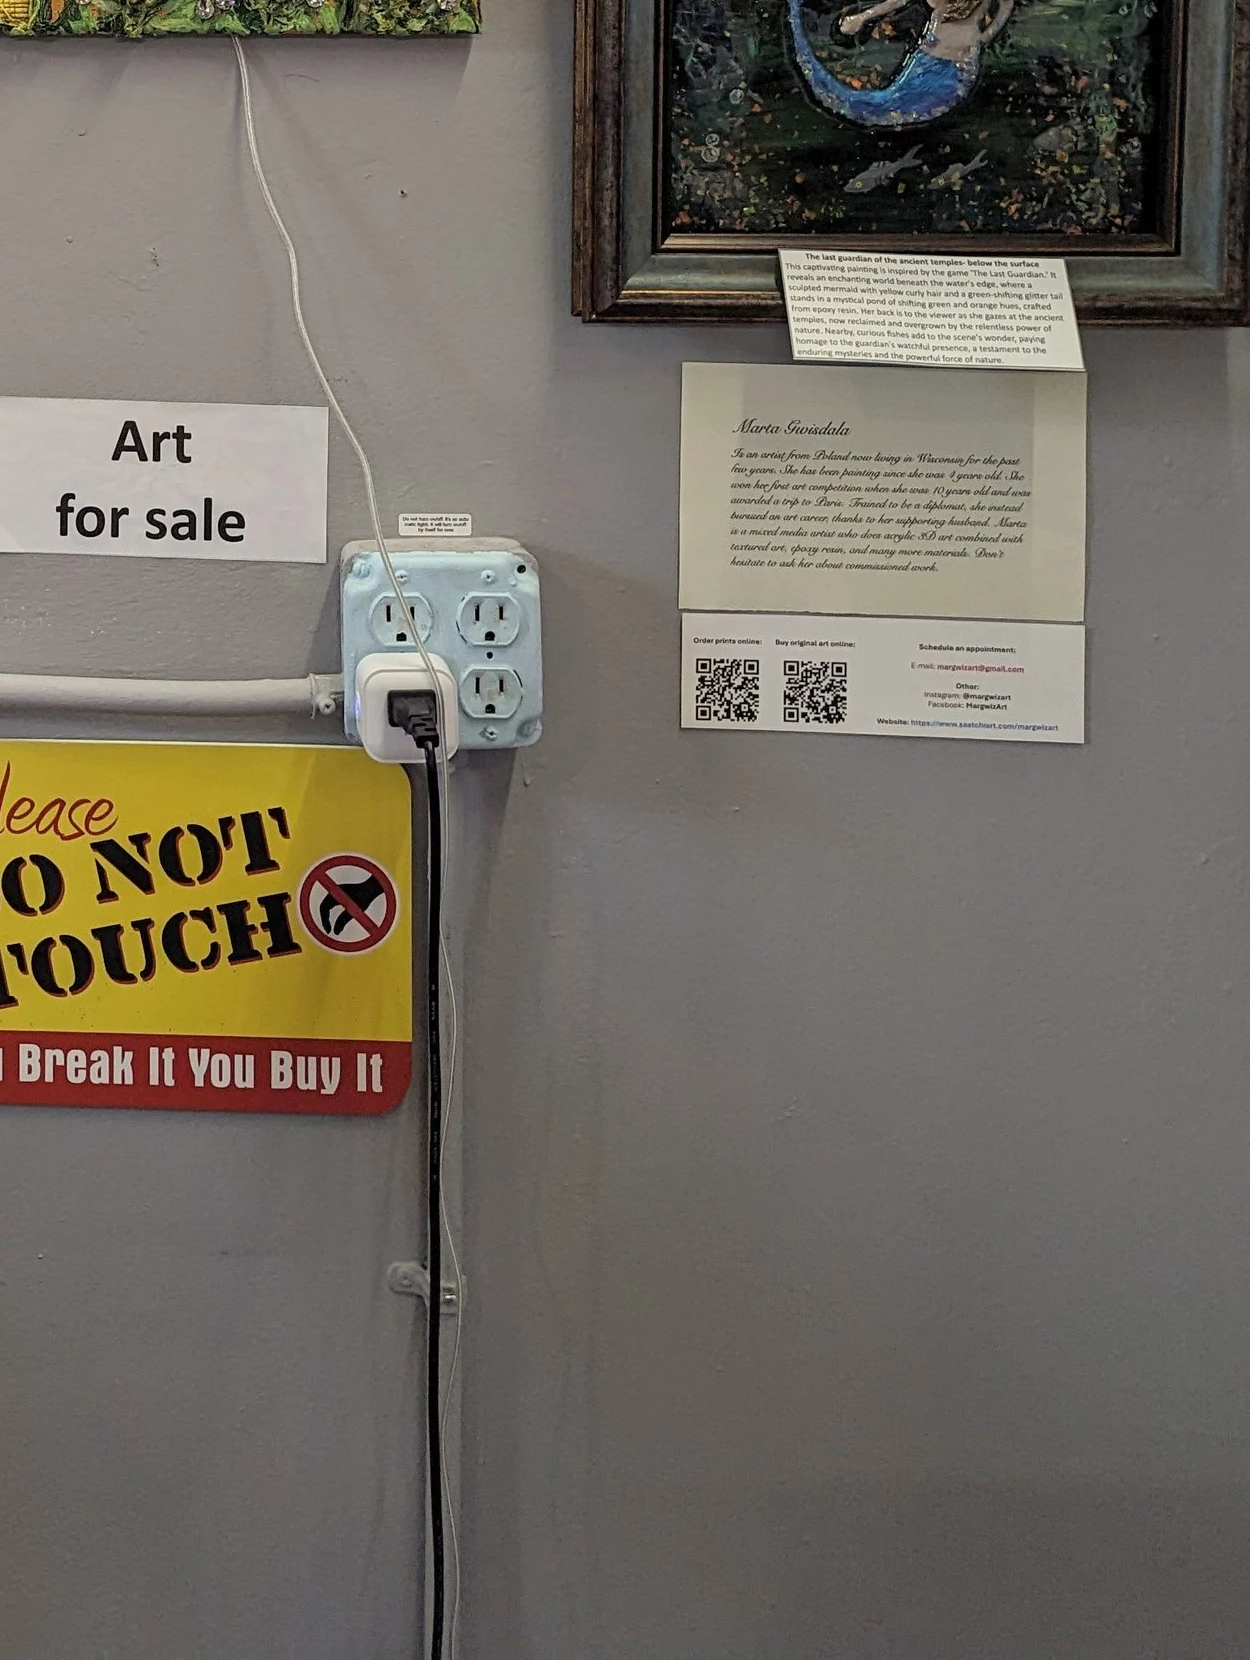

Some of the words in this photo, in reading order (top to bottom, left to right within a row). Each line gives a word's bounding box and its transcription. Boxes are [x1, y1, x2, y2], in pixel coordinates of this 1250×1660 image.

[838, 254, 872, 263] guardian
[931, 259, 965, 267] temples-
[803, 264, 845, 272] captivating
[847, 266, 878, 274] painting
[888, 267, 918, 275] inspired
[947, 271, 968, 279] game
[828, 276, 871, 284] enchanting
[896, 278, 928, 286] beneath
[789, 284, 821, 292] sculpted
[968, 291, 1023, 300] green-shifting
[1025, 292, 1048, 300] glitter
[732, 418, 781, 434] Marta
[111, 420, 192, 463] Art
[731, 448, 744, 458] Is
[761, 451, 786, 459] artist
[781, 449, 810, 462] from
[813, 450, 852, 462] Poland
[851, 454, 872, 462] now
[874, 452, 900, 465] living
[903, 454, 913, 462] in
[918, 453, 964, 466] Wisconsin
[961, 454, 981, 467] for
[982, 455, 998, 465] the
[996, 457, 1020, 468] past
[731, 463, 747, 473] few
[746, 468, 776, 477] years.
[780, 464, 799, 474] She
[800, 465, 816, 475] has
[819, 465, 839, 476] been
[839, 468, 880, 480] painting
[907, 469, 924, 478] she
[952, 474, 983, 483] years
[985, 471, 1002, 480] old.
[1005, 471, 1025, 481] She
[56, 493, 129, 538] for
[145, 497, 245, 542] sale
[715, 637, 736, 645] prints
[776, 639, 788, 647] Buy
[919, 643, 954, 651] Schedule
[966, 646, 1016, 654] appointment:
[956, 682, 979, 690] Other:
[924, 691, 961, 699] Instagram:
[963, 693, 1011, 701] @margwizart
[966, 702, 1007, 711] MargwizArt
[877, 717, 909, 725] Website:
[90, 807, 291, 904] NOT
[19, 1042, 134, 1086] Break
[149, 1045, 177, 1087] It
[188, 1046, 254, 1089] You
[271, 1049, 341, 1095] Buy
[357, 1052, 383, 1094] It
